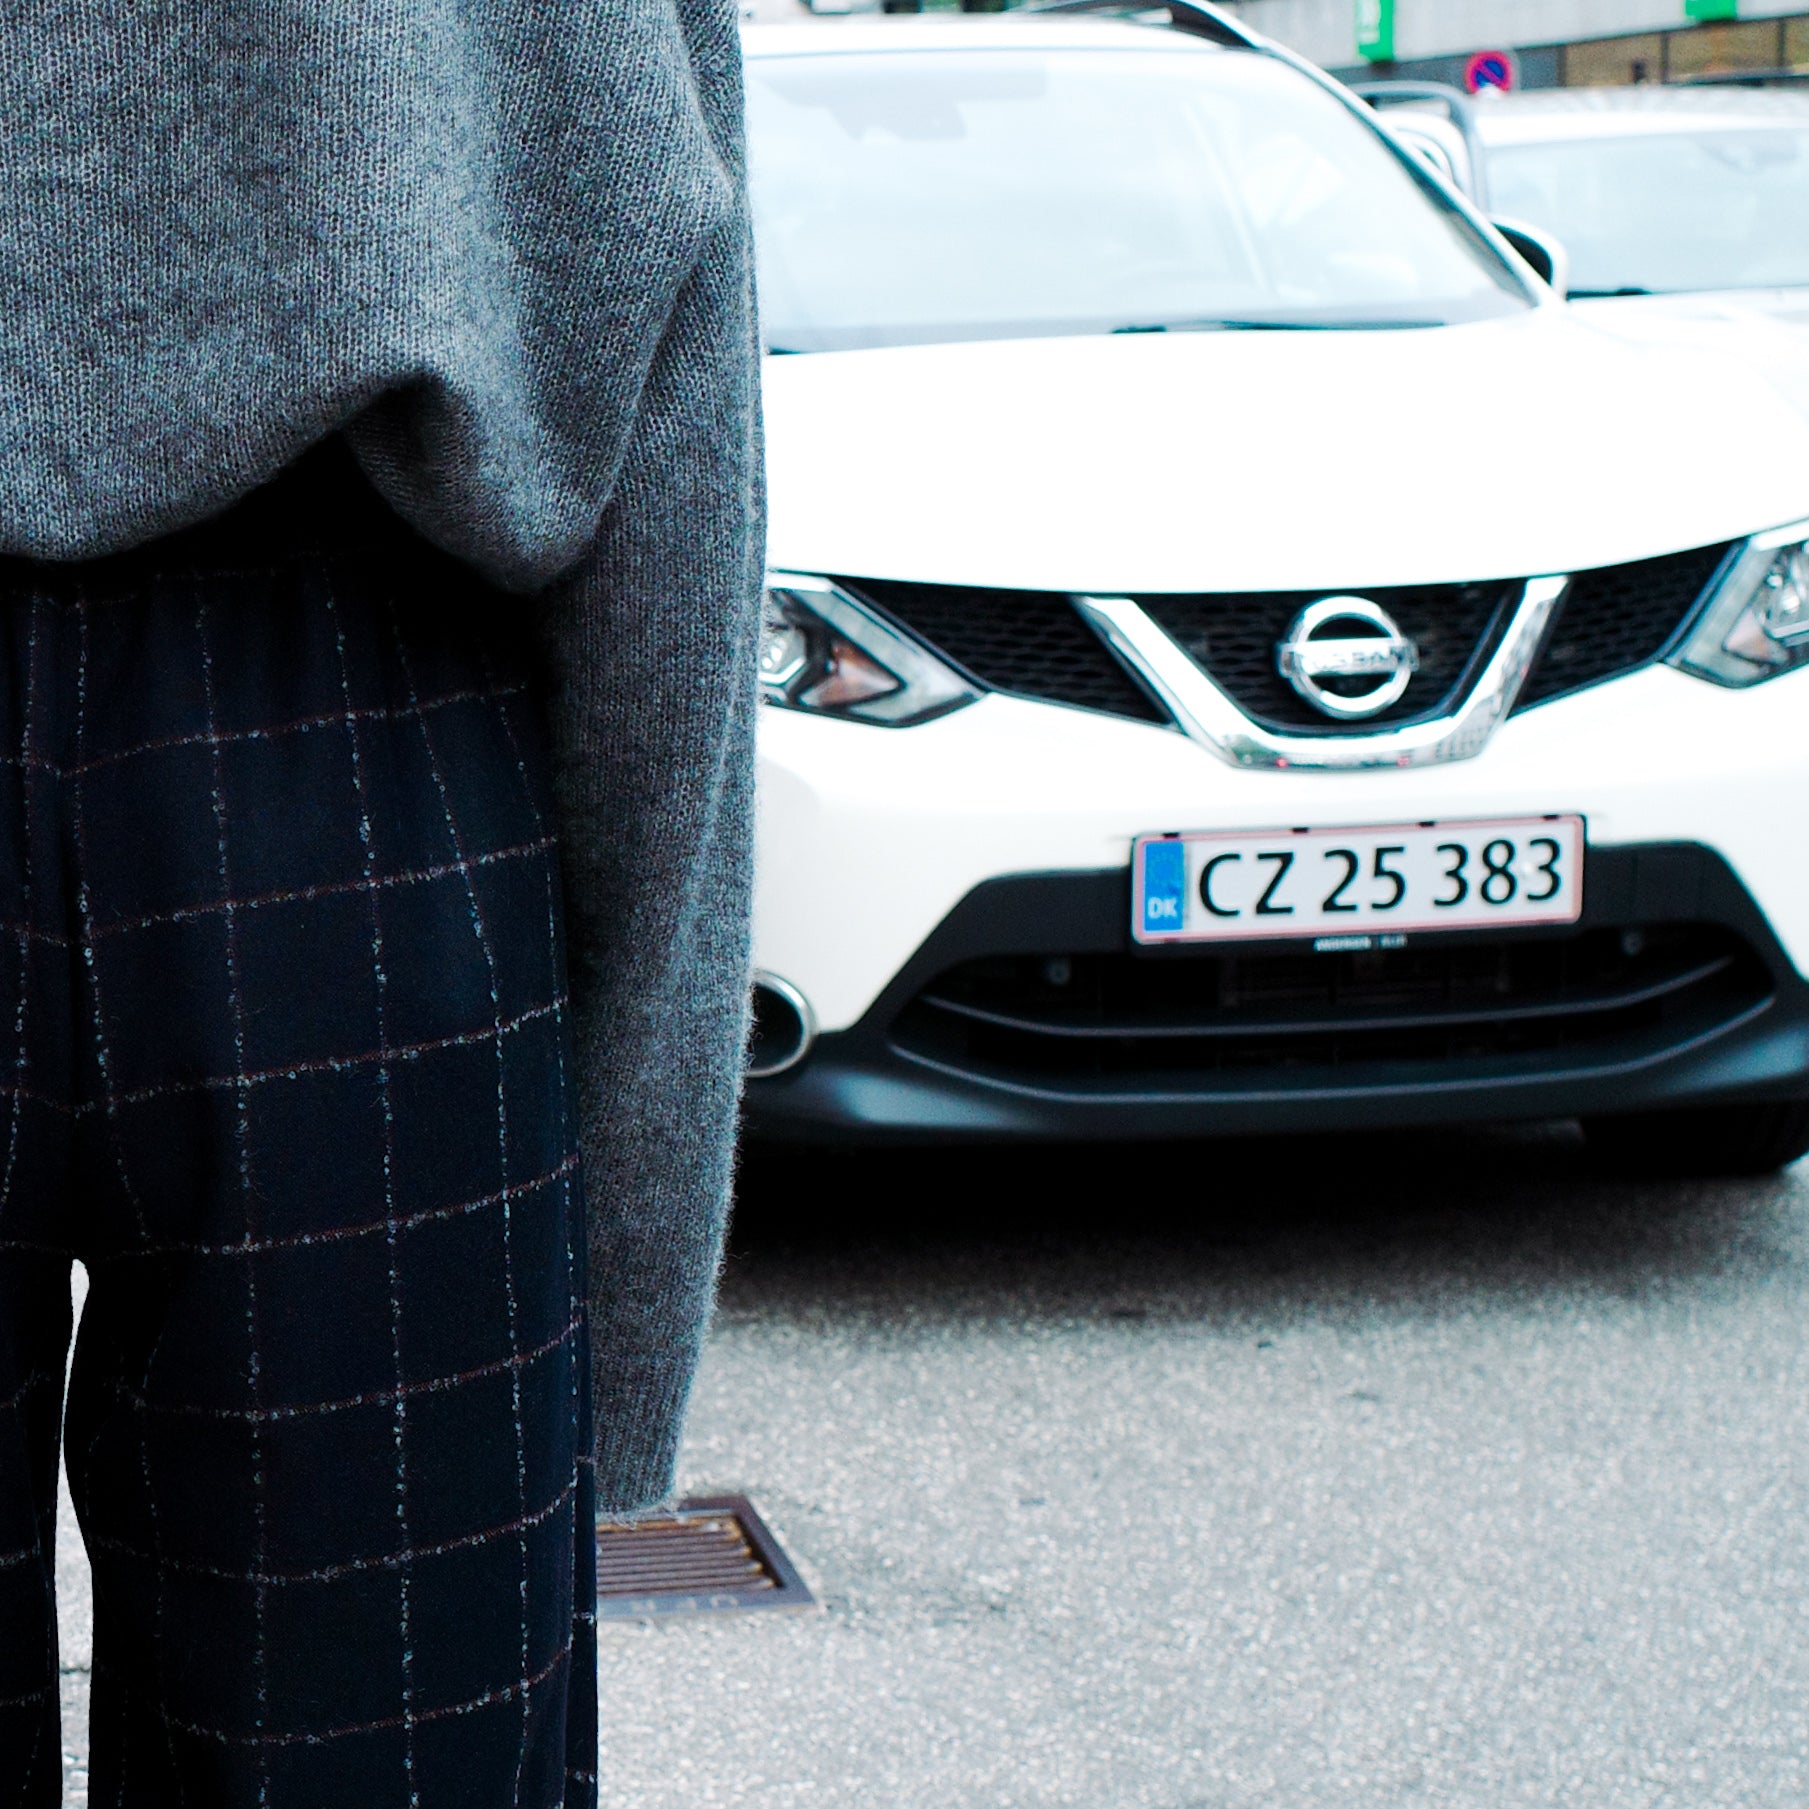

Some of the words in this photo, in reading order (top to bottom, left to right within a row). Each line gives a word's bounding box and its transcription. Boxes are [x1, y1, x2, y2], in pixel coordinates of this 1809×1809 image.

[1198, 851, 1295, 918] CZ
[1321, 846, 1408, 913] 25
[1432, 837, 1563, 907] 383
[1147, 896, 1178, 919] DK
